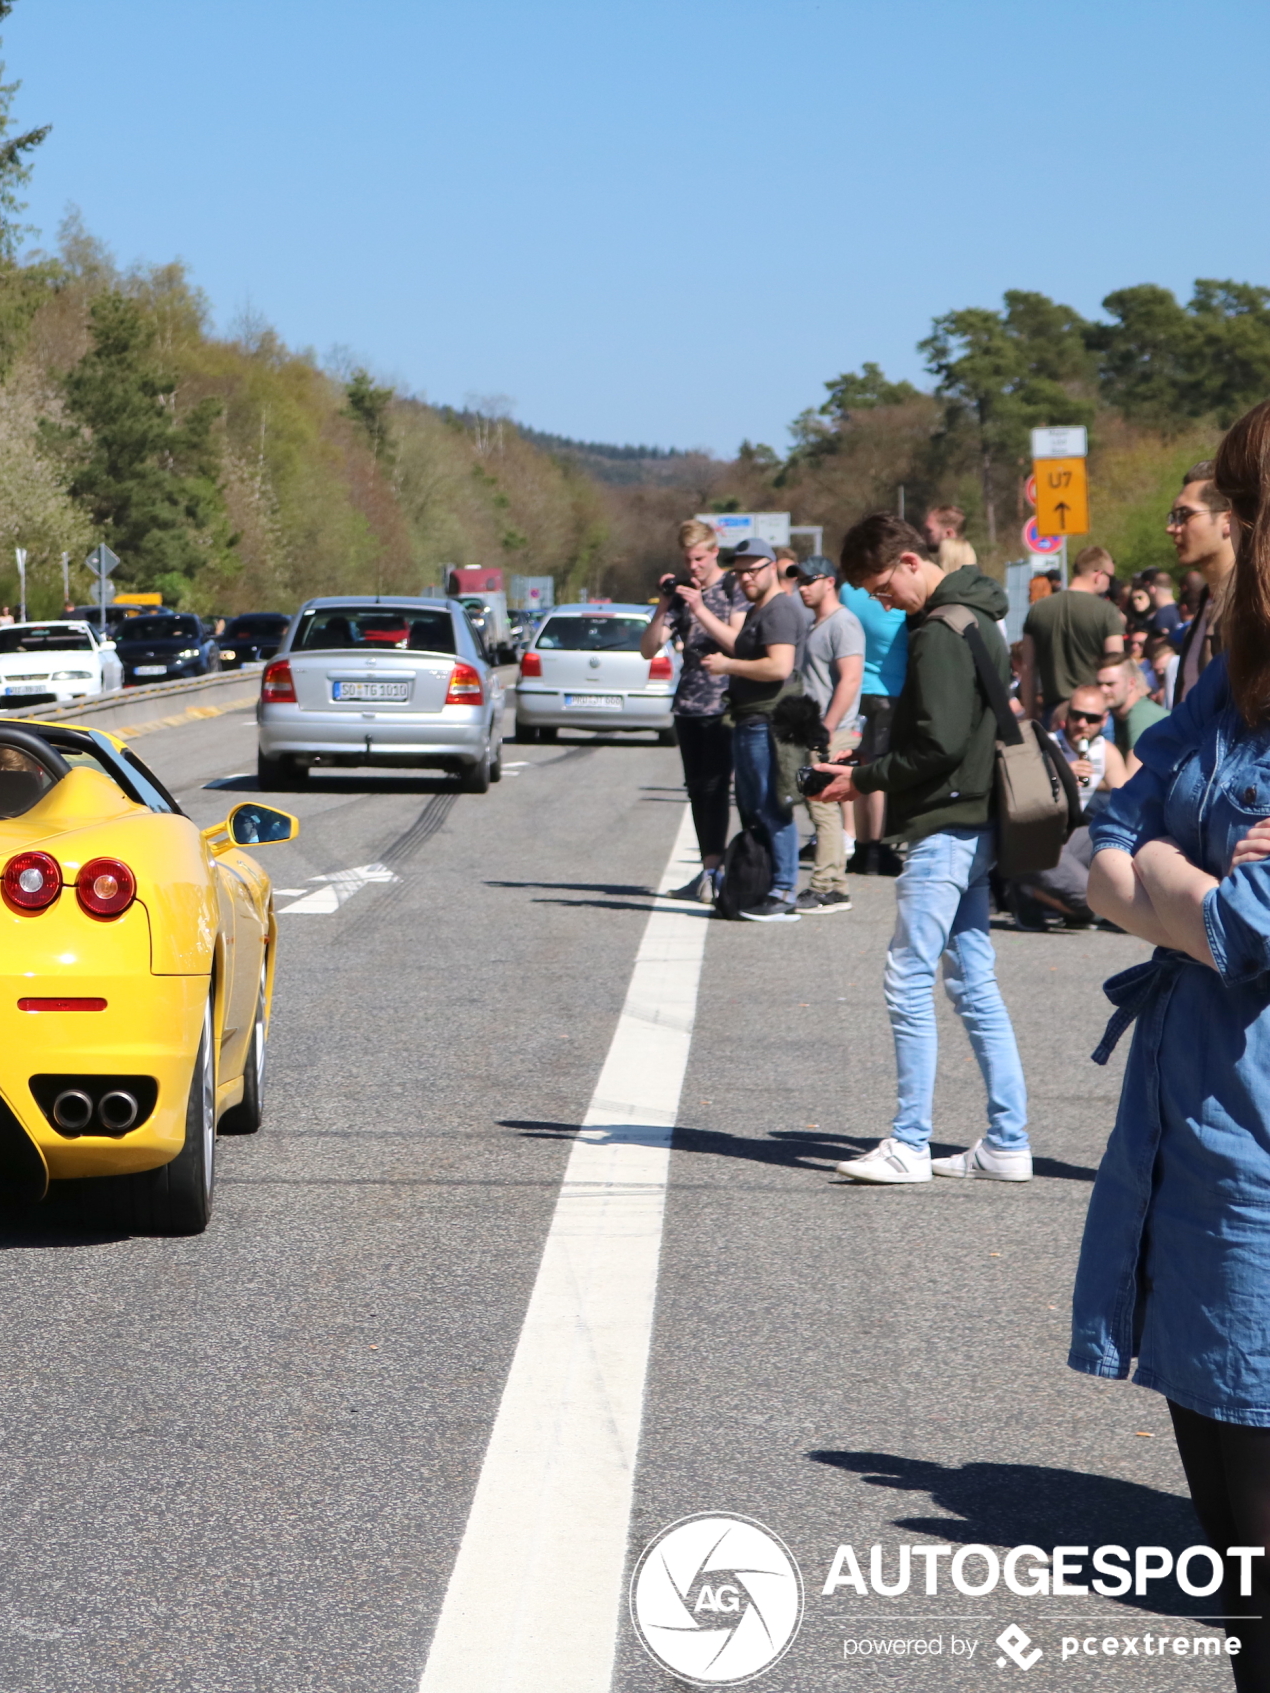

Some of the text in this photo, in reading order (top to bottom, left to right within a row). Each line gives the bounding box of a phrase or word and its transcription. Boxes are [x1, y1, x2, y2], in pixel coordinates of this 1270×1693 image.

[1048, 471, 1072, 488] U7
[364, 684, 377, 696] TG
[380, 684, 407, 696] 1010
